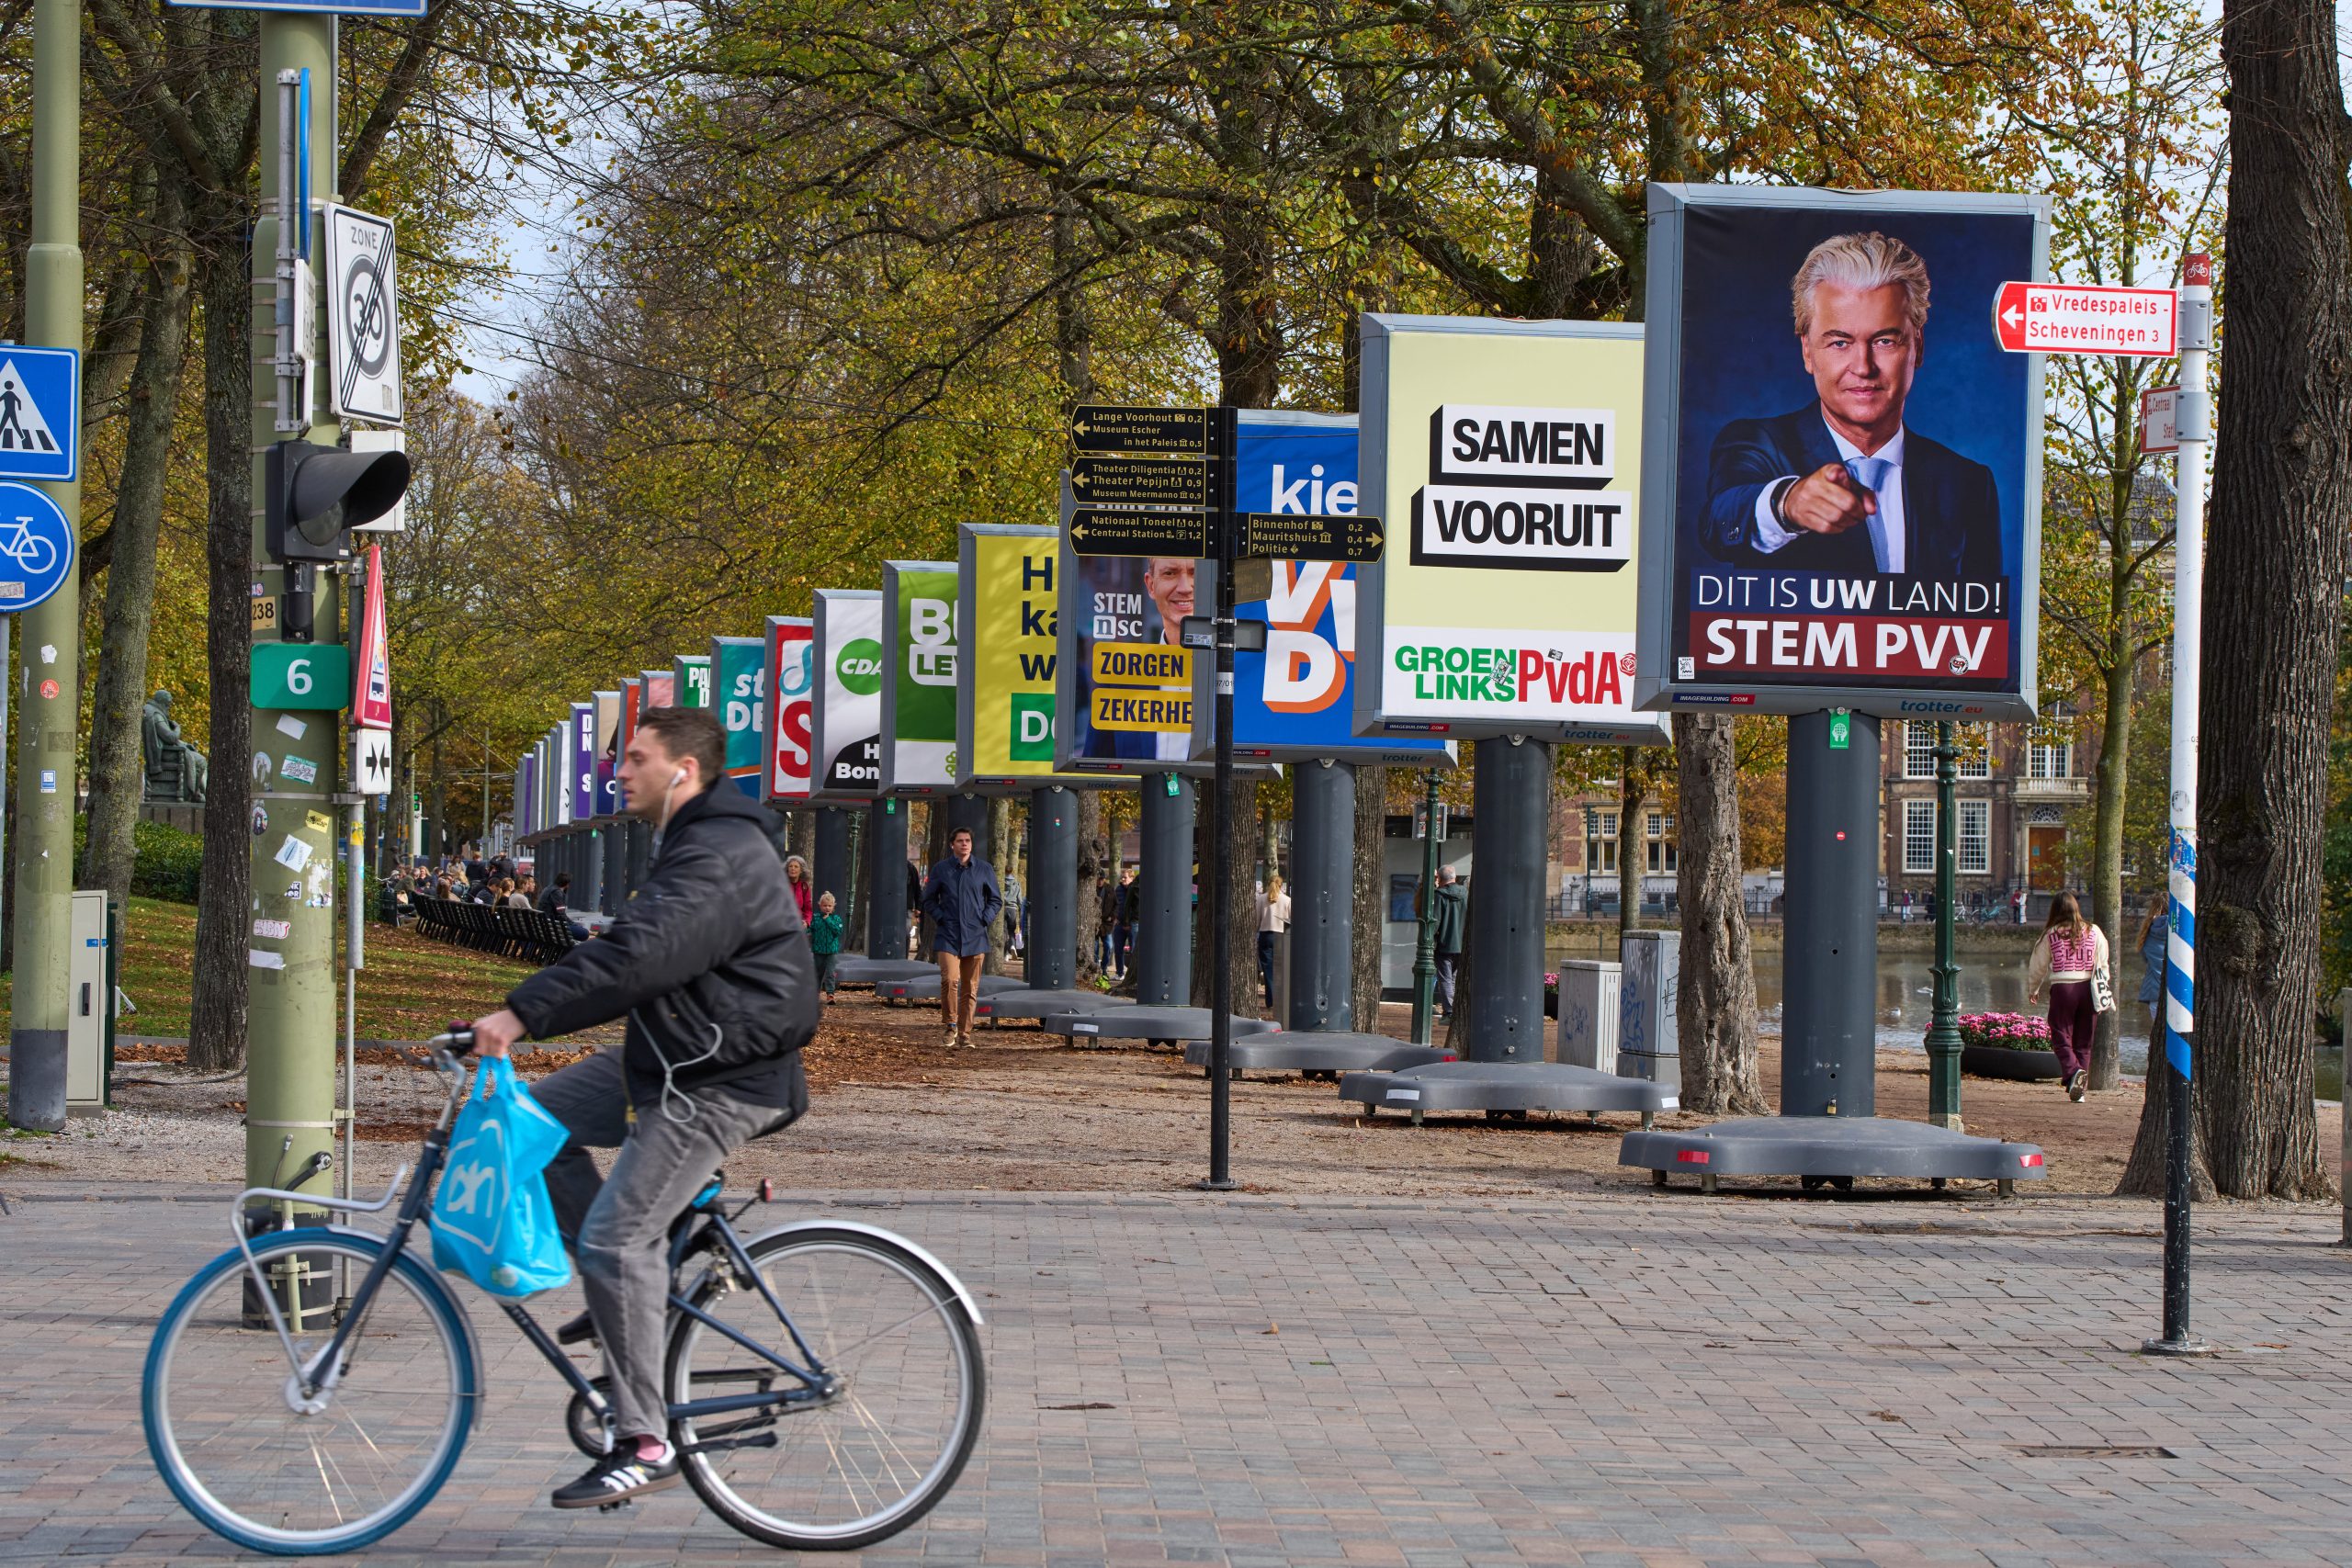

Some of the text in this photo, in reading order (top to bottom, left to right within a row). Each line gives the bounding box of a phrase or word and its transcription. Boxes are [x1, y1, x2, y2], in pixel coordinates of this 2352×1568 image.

[350, 226, 378, 250] ZONE
[2052, 294, 2157, 316] Vredespaleis
[353, 293, 383, 341] 30
[2030, 321, 2159, 345] Scheveningen 3
[2153, 395, 2172, 412] Centraal
[1093, 412, 1202, 423] Lange Voorhout 0,2
[1093, 425, 1161, 434] Museum Escher
[1136, 438, 1149, 446] het
[1152, 438, 1178, 446] Paleis
[1452, 418, 1604, 466] SAMEN
[1093, 465, 1202, 476] Theater Diligentia 0,2
[1093, 476, 1133, 485] Theater
[1136, 477, 1169, 488] Pepijn
[1093, 489, 1127, 498] Museum
[1130, 491, 1178, 499] Meermanno
[1091, 516, 1139, 525] Nationaal
[1143, 517, 1176, 526] Toneel
[1253, 520, 1363, 533] Binnenhof 0,2
[1433, 499, 1622, 547] VOORUIT
[1091, 528, 1129, 537] Centraal
[1132, 529, 1165, 538] Station
[1252, 531, 1317, 542] Mauritshuis
[1252, 544, 1288, 553] Politie
[1093, 592, 1141, 615] STEM
[1698, 575, 2001, 614] DIT IS UW LAND!
[252, 603, 274, 621] 238
[910, 598, 957, 646] B
[1094, 616, 1142, 637] nsc
[1706, 618, 1859, 668] STEM
[1876, 624, 1993, 671] PVV
[917, 653, 957, 676] LE
[1100, 651, 1183, 678] ZORGEN
[1394, 645, 1517, 674] GROEN
[287, 659, 312, 694] 6
[689, 667, 711, 687] PA
[1518, 649, 1623, 705] PvdA
[1415, 673, 1516, 703] LINKS
[1099, 698, 1192, 724] ZEKERHE
[1900, 700, 1984, 714] trotter.eu
[1020, 710, 1056, 742] D
[2053, 948, 2093, 963] CLUB
